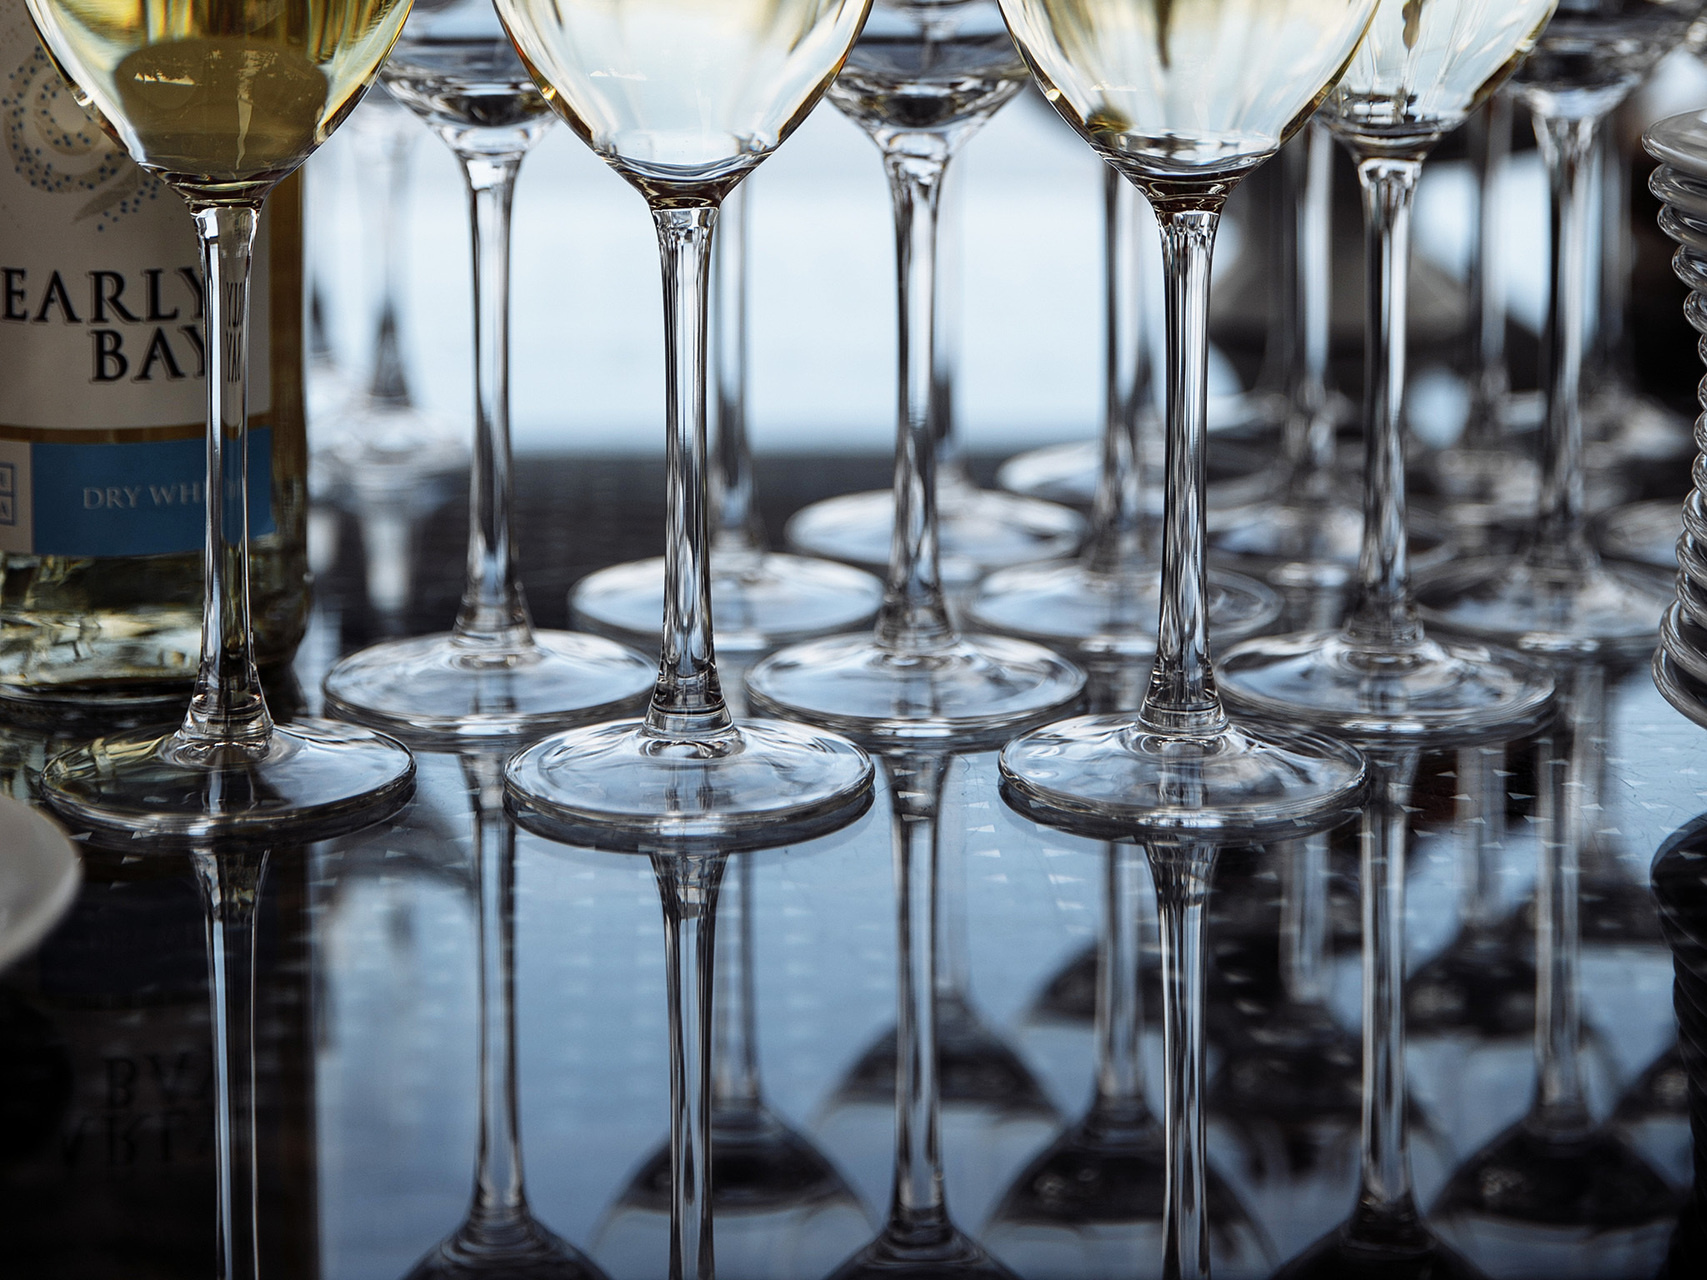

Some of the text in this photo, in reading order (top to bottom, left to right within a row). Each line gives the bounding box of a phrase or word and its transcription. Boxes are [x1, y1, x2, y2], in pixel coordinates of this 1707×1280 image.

[1, 267, 203, 325] EARLY
[89, 324, 204, 384] BAY
[82, 483, 142, 510] DRY
